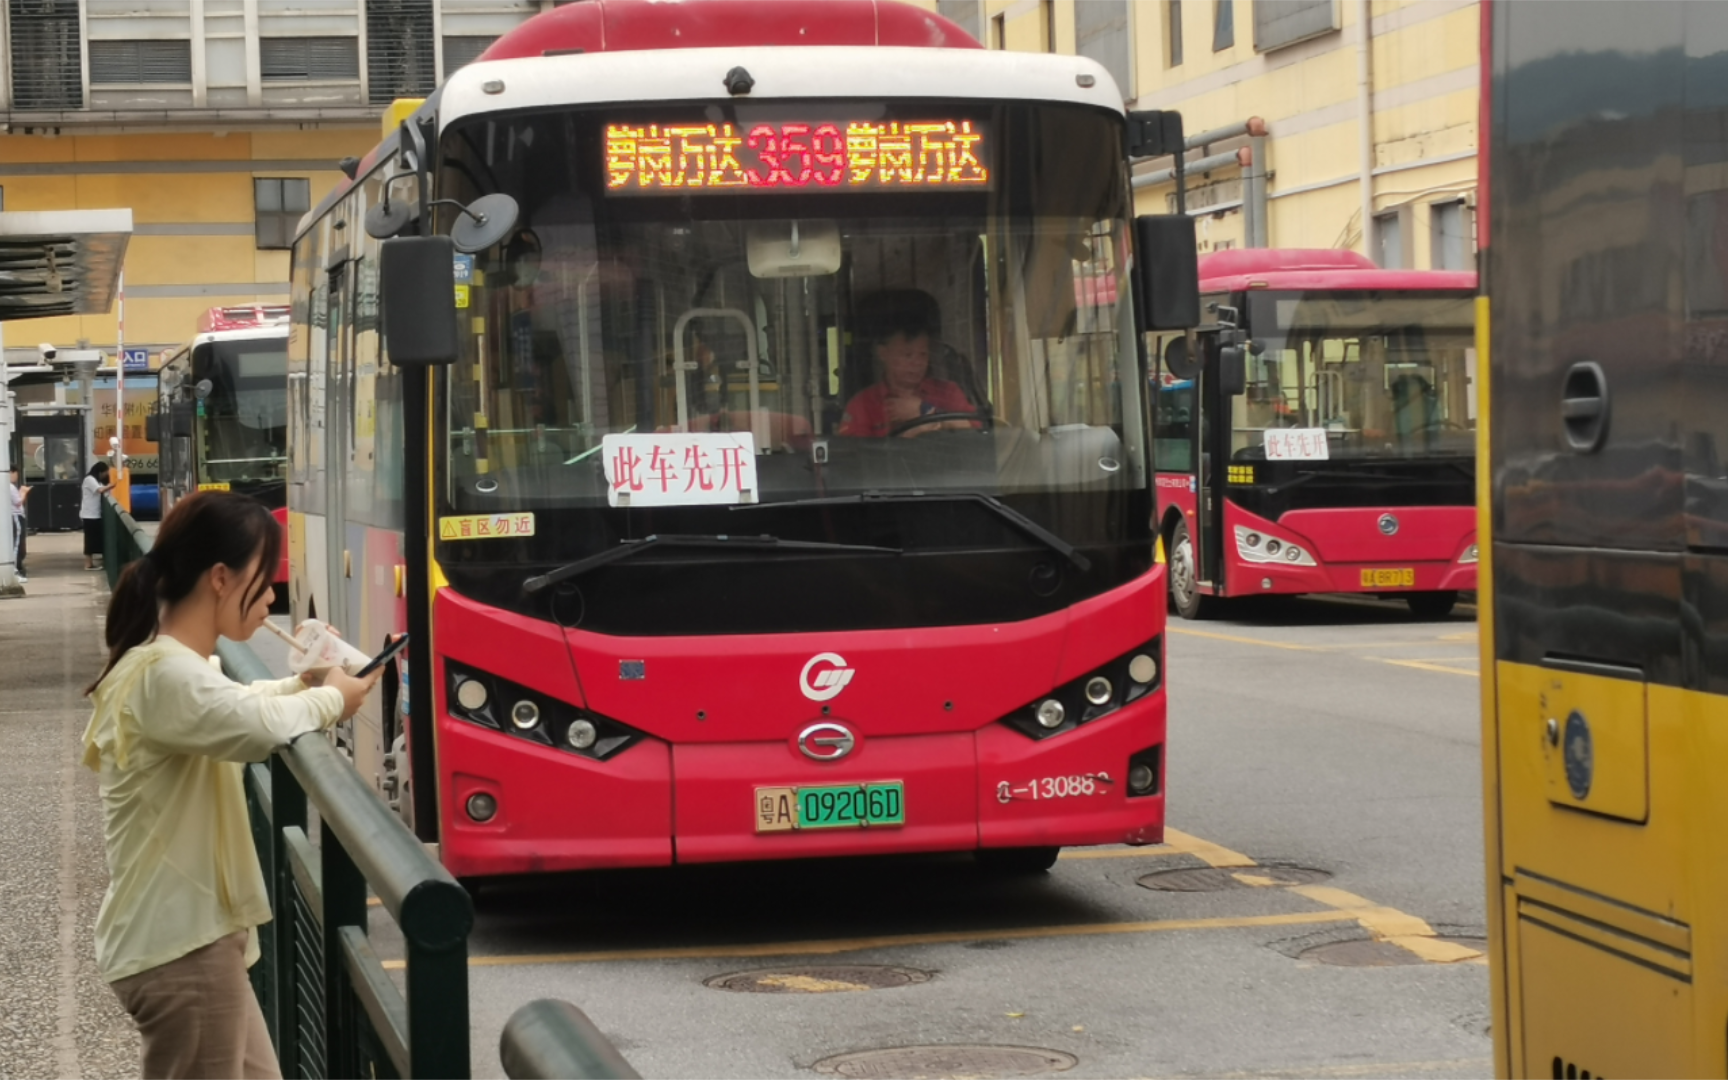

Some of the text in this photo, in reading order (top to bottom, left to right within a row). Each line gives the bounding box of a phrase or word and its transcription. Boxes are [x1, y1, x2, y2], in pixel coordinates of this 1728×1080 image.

[123, 351, 146, 363] 入口
[1267, 433, 1325, 458] 此车先开
[612, 444, 748, 493] 此车先开
[458, 516, 531, 537] 盲区勿近
